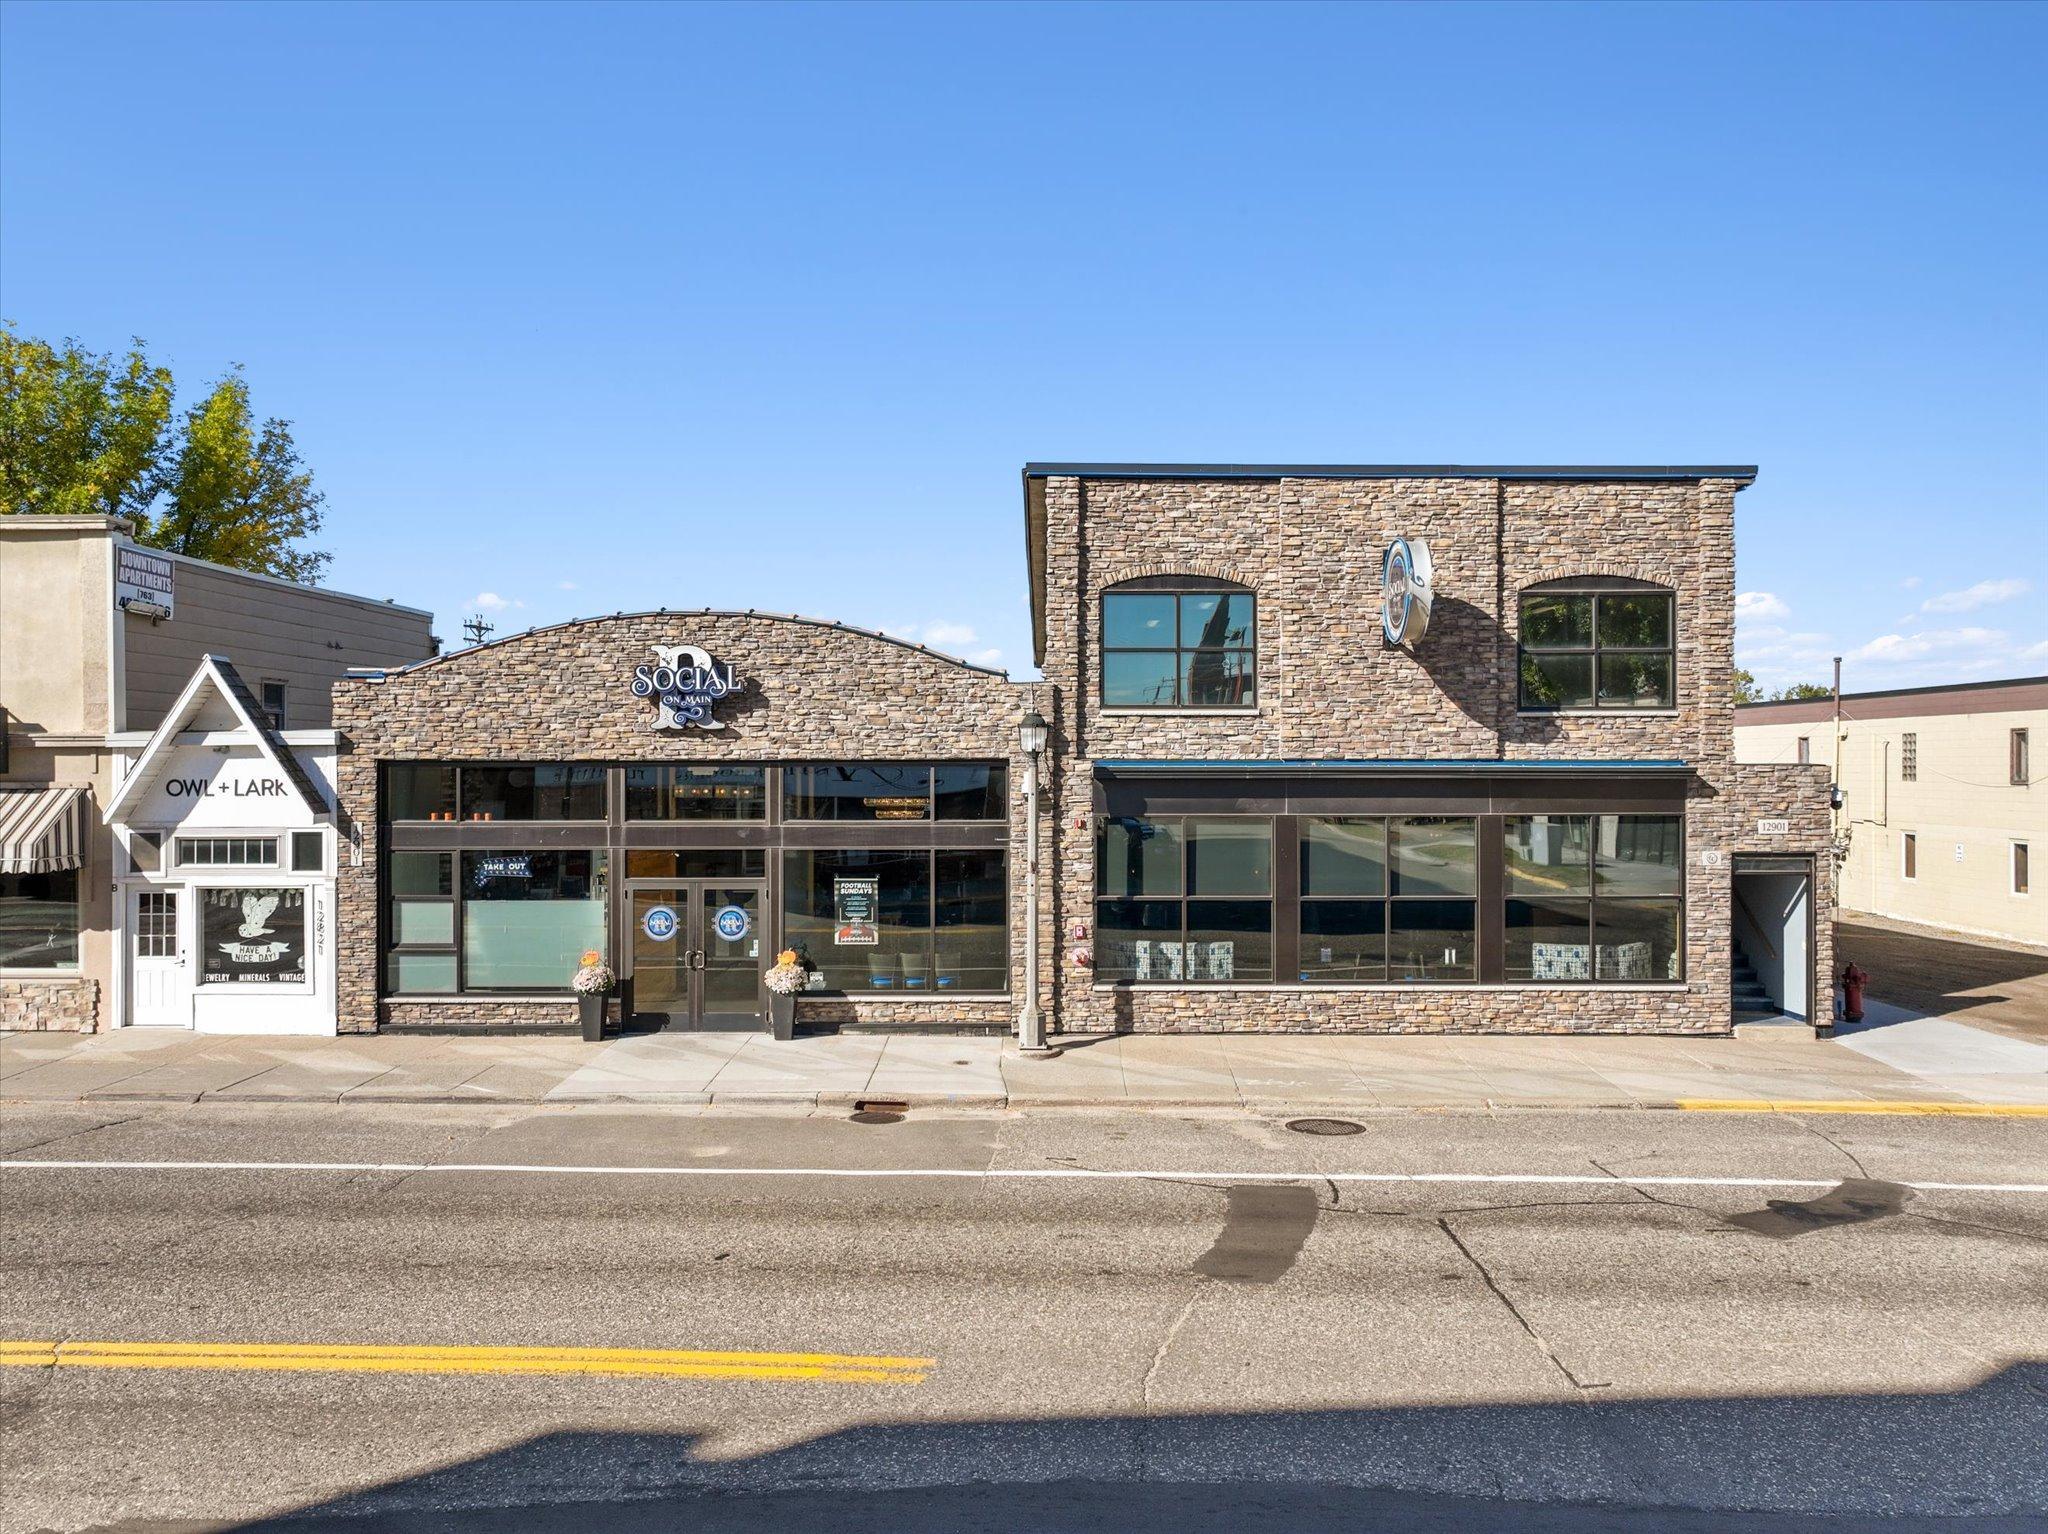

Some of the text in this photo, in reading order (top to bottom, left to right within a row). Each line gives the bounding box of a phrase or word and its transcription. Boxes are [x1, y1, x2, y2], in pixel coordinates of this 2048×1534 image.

[121, 551, 171, 576] DOWNTOWN
[119, 566, 173, 592] APARTMENTS
[631, 665, 742, 696] SOCIAL
[663, 695, 711, 706] ON MAIN
[166, 779, 215, 797] OWL
[234, 778, 288, 797] LARK
[1762, 822, 1786, 832] 12901
[483, 863, 504, 871] TAKE
[239, 946, 260, 954] HAVE
[235, 953, 253, 962] NICE
[203, 973, 305, 982] EWELRY MINERALS VINTAGE
